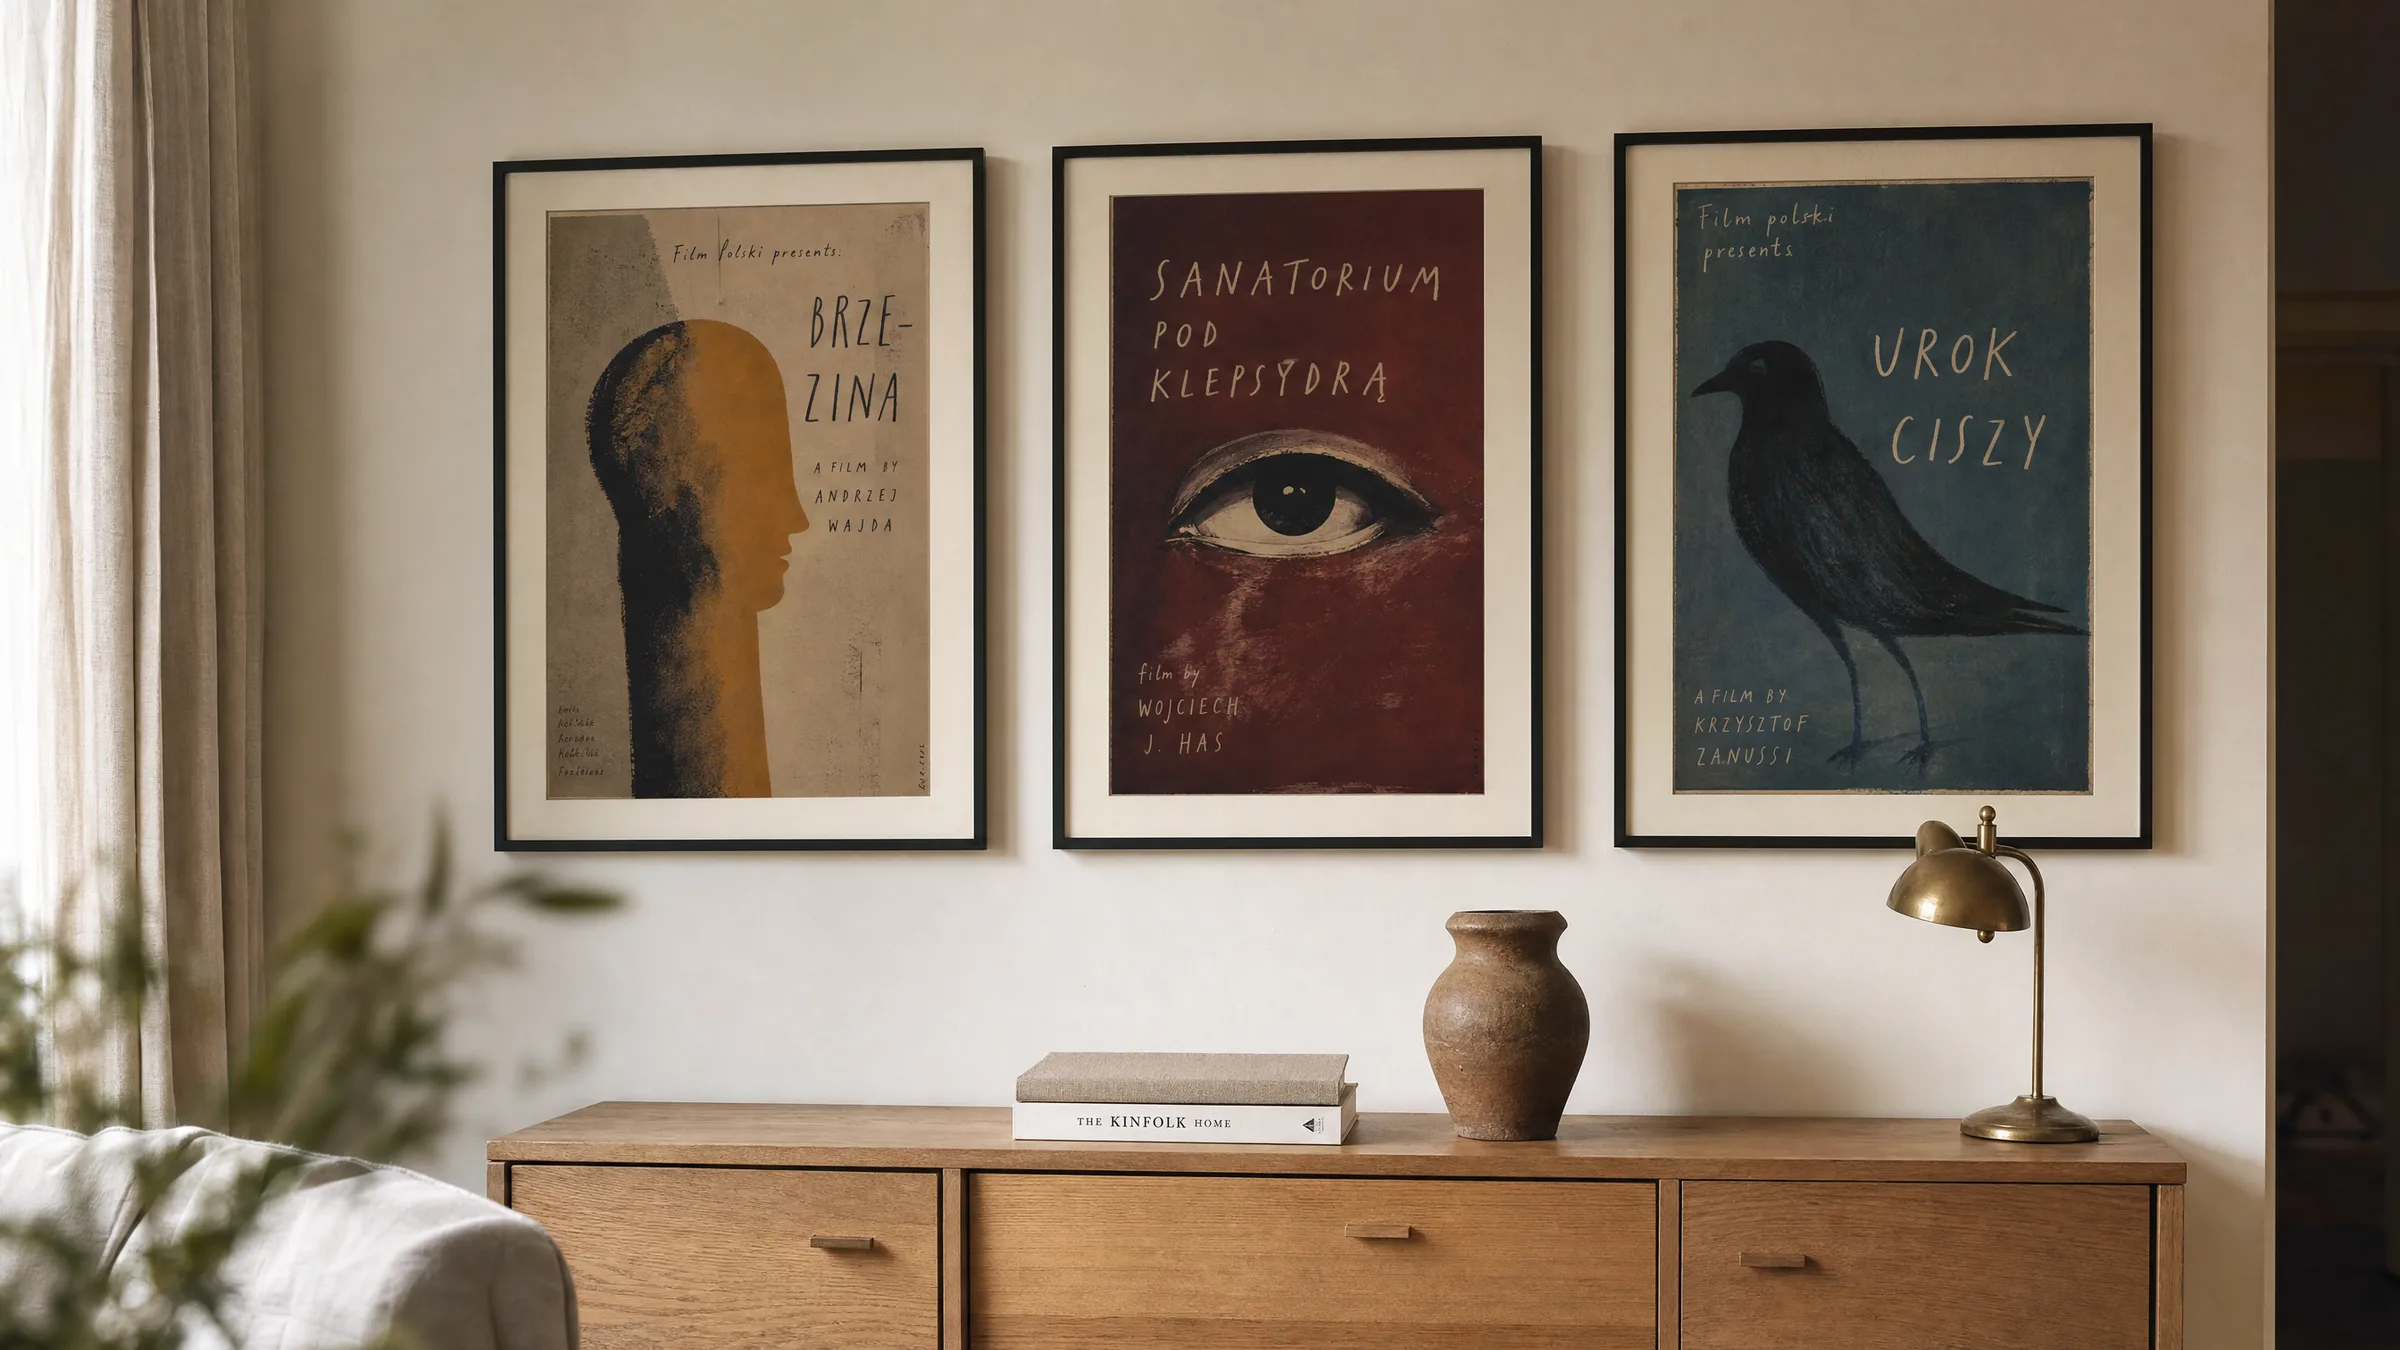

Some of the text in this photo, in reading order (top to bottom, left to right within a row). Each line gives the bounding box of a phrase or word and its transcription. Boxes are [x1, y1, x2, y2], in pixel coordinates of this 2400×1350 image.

[1698, 203, 1835, 237] Film polski
[673, 244, 708, 264] Film
[771, 243, 842, 266] presents:
[1703, 237, 1793, 273] presents
[1150, 259, 1440, 301] SANATORIUM
[810, 294, 913, 349] BRZE-
[1154, 320, 1218, 349] POD
[1874, 327, 2018, 381] UROK
[804, 372, 899, 423] ZINA
[1892, 414, 2047, 470] CISZY
[813, 460, 898, 474] A FILM BY
[815, 488, 897, 504] ANDRZEJ
[828, 518, 892, 533] WAJDA
[1138, 662, 1201, 689] film by
[1139, 696, 1239, 724] WOJCIECH
[1694, 688, 1787, 705] A FILM BY
[1694, 714, 1810, 734] KRZYSZTOF
[1144, 732, 1223, 755] J. HAS
[1696, 746, 1792, 766] ZANUSSI
[1077, 1115, 1232, 1129] THE KINFOLK HOME
